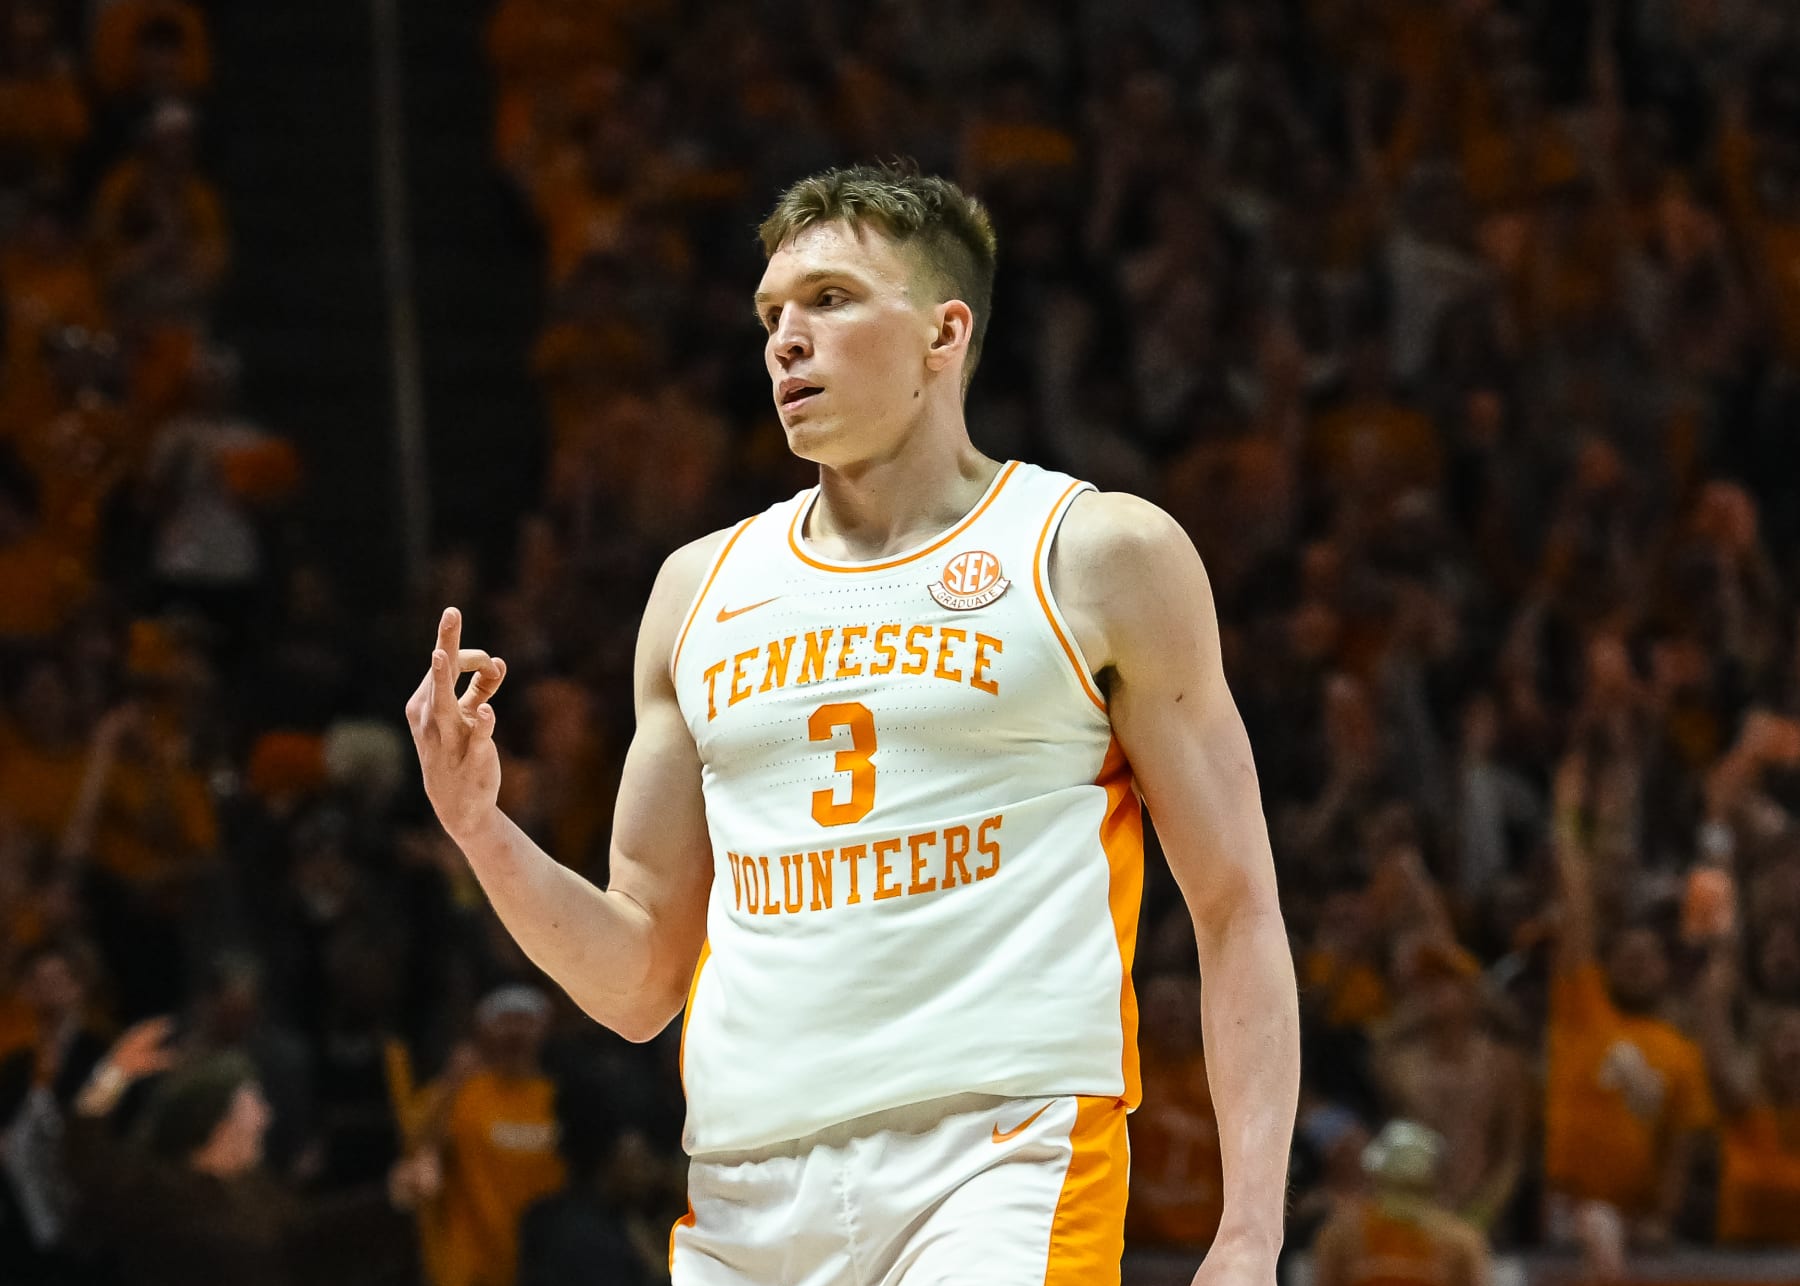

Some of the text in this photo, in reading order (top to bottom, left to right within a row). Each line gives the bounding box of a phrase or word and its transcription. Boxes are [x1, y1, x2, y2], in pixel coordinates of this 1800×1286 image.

[936, 589, 998, 609] GRADUATE
[947, 552, 996, 593] SEC
[703, 624, 1003, 722] TENNESSEE
[808, 702, 877, 827] 3
[727, 814, 1003, 916] VOLUNTEERS
